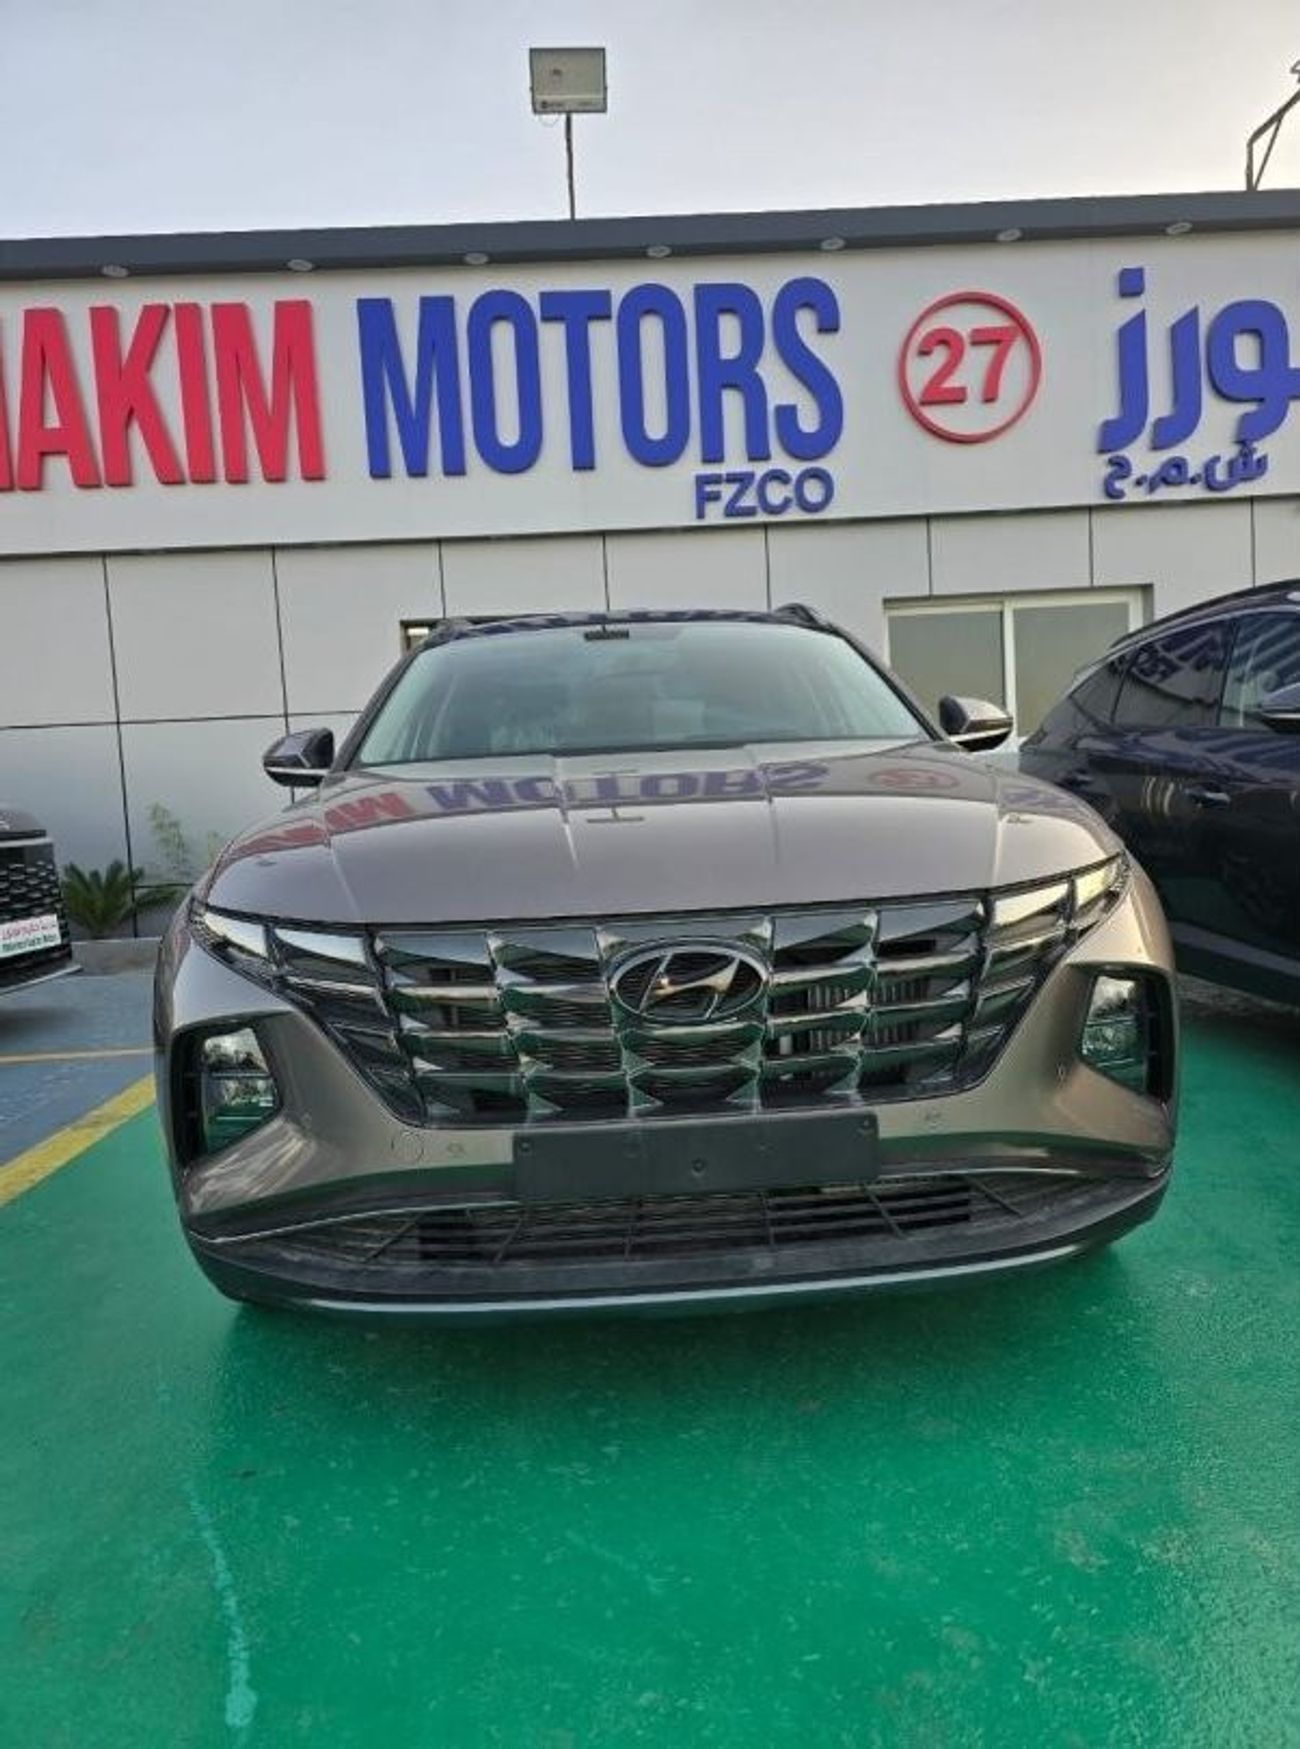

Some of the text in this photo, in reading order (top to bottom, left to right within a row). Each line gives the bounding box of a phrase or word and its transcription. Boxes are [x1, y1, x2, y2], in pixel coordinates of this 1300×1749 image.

[357, 277, 844, 479] MOTORS
[917, 325, 1021, 407] 27
[1096, 266, 1300, 454] ورز
[695, 467, 834, 519] FZCO
